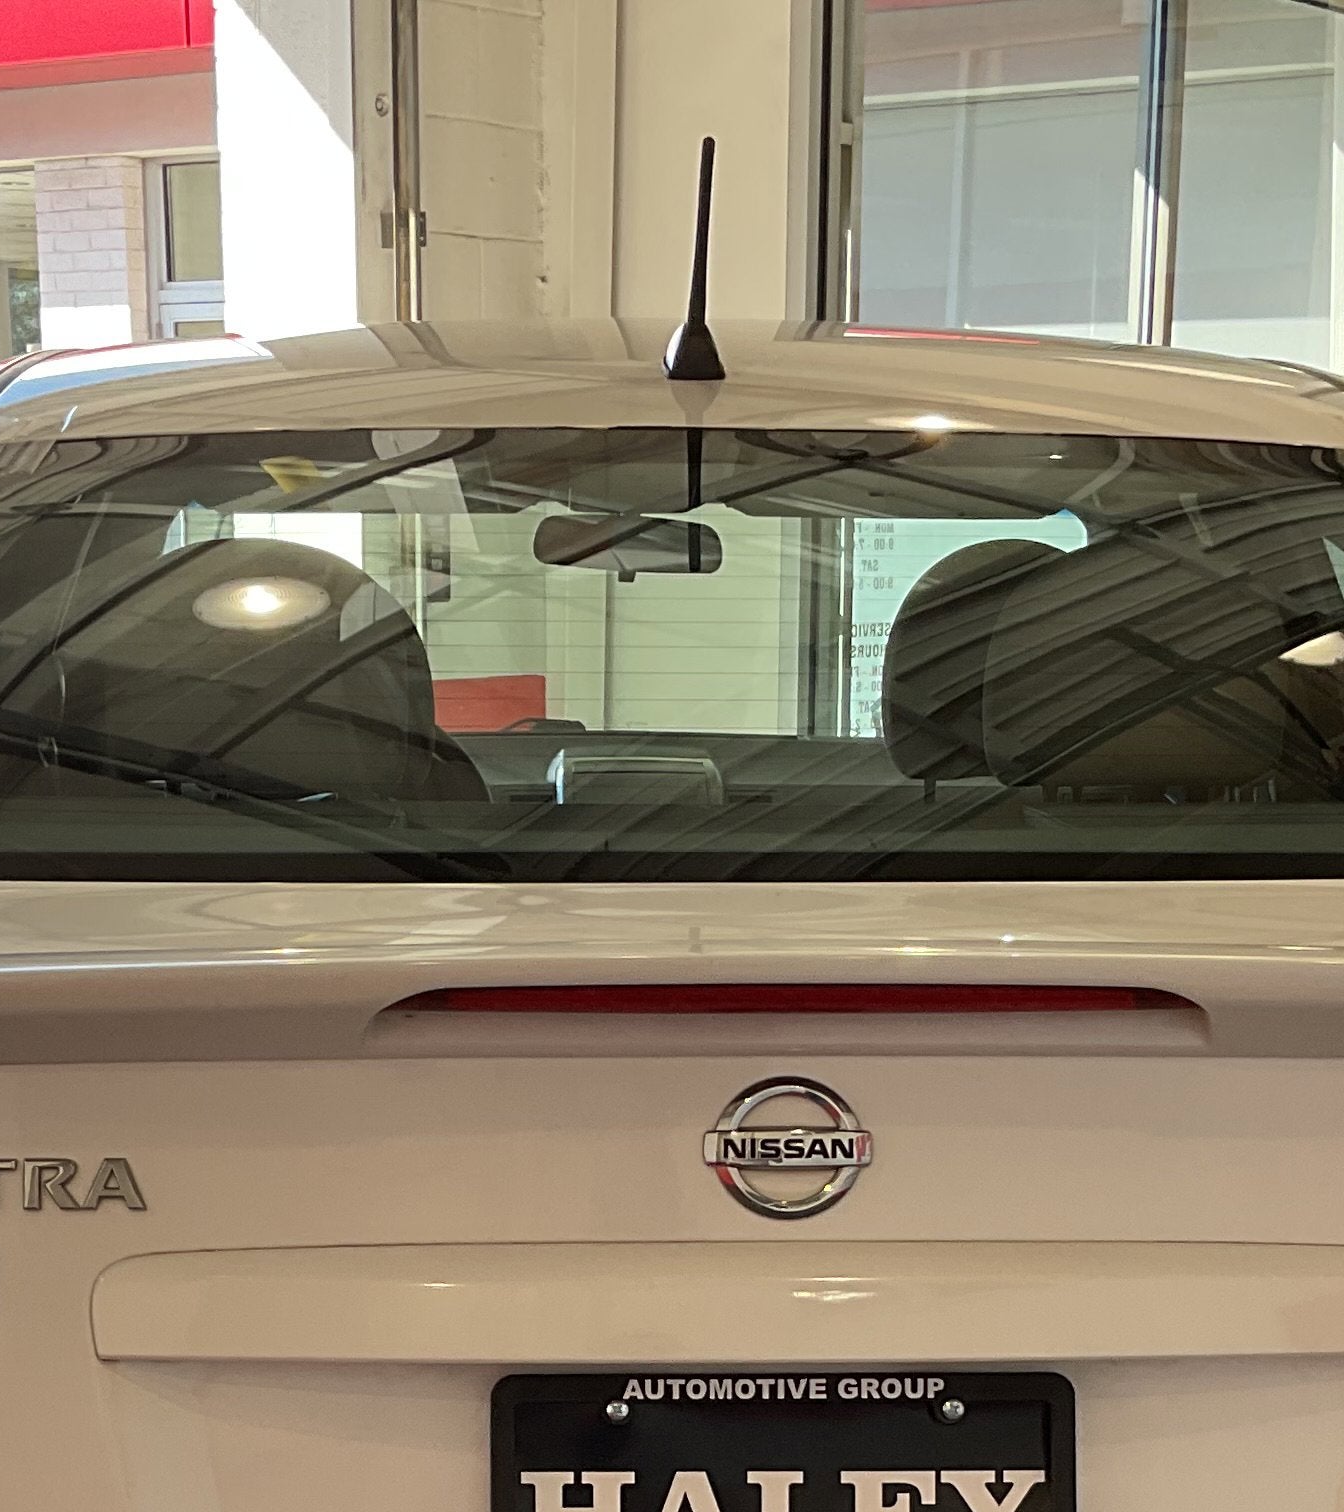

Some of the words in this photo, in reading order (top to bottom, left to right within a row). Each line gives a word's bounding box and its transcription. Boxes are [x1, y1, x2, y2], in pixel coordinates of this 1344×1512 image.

[723, 1137, 854, 1159] NISSAN
[622, 1377, 827, 1401] AUTOMOTIVE
[837, 1377, 945, 1400] GROUP
